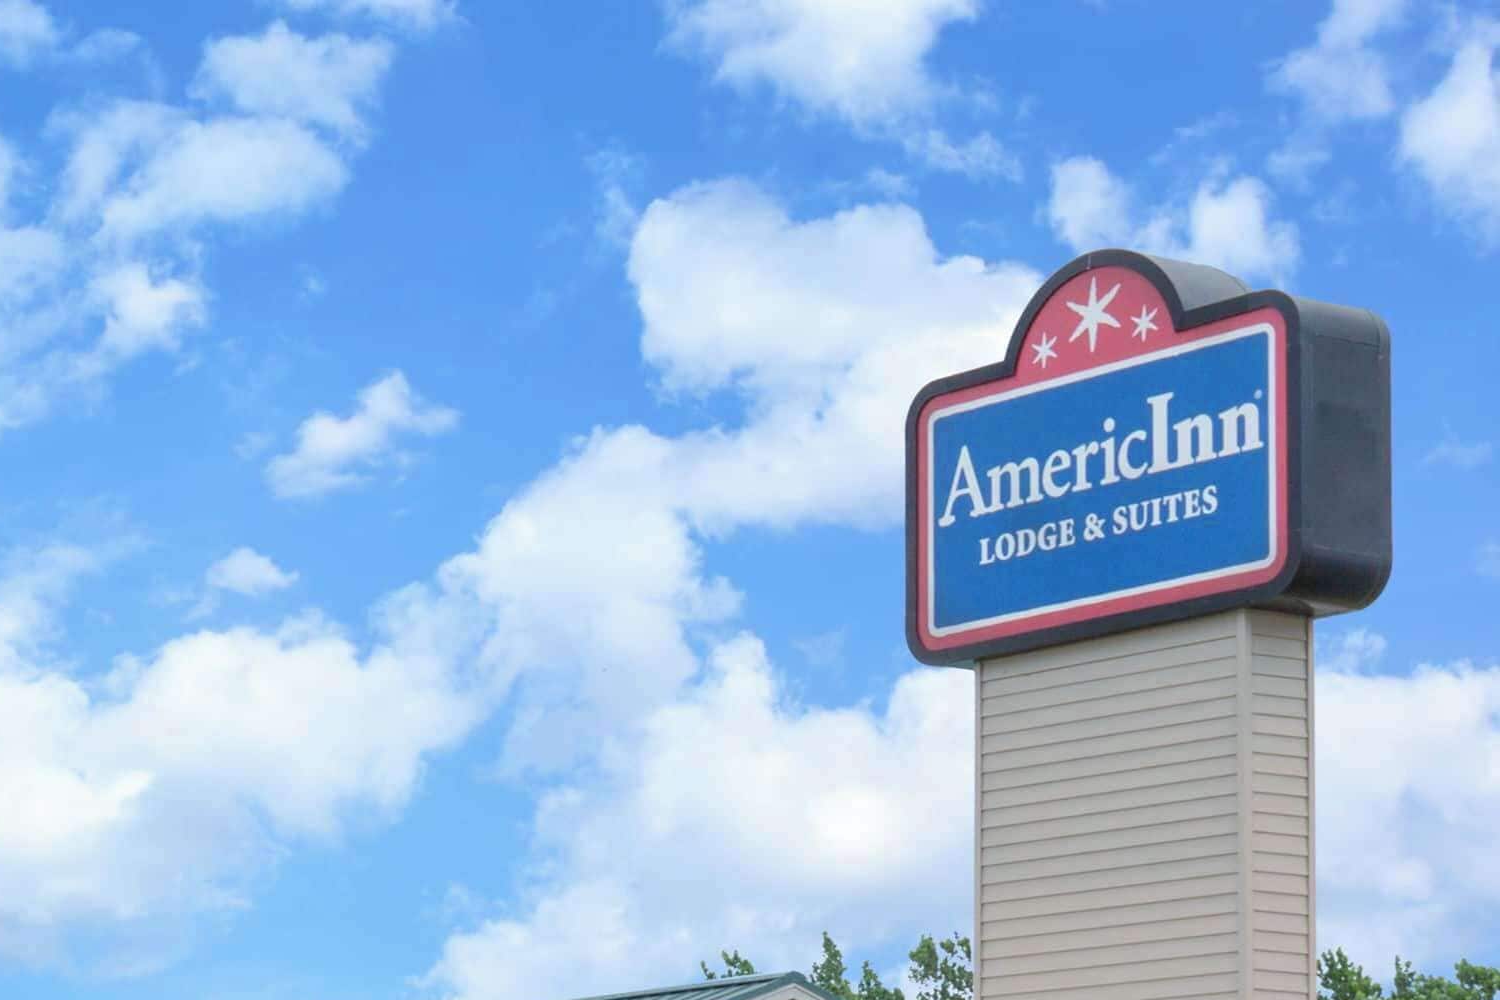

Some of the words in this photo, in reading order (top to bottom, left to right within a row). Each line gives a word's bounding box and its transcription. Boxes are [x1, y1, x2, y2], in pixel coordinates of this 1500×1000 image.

[938, 392, 1264, 527] AmericInn
[979, 518, 1076, 566] LODGE
[1083, 513, 1105, 542] &
[1112, 485, 1219, 535] SUITES
